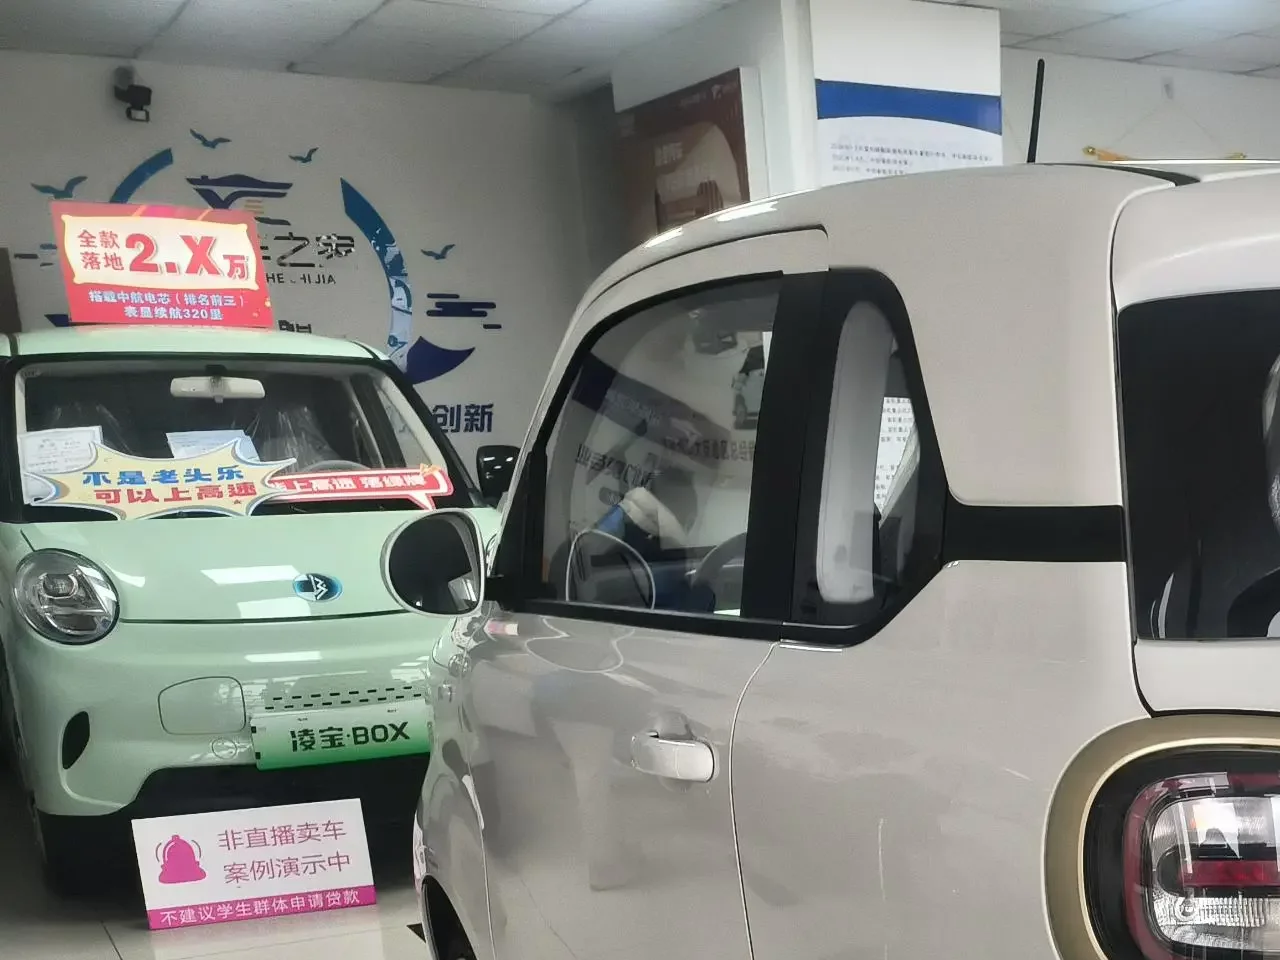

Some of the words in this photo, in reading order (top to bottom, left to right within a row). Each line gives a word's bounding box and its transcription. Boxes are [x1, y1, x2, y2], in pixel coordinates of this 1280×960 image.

[77, 229, 121, 249] 全款
[79, 251, 125, 271] 落地
[432, 403, 495, 433] 创新
[82, 464, 245, 487] 不是老头乐
[93, 482, 258, 504] 可以上高速
[217, 819, 348, 851] 非直播卖车
[222, 850, 351, 884] 案例演示中
[159, 888, 361, 927] 不建议学生群体申请贷款
